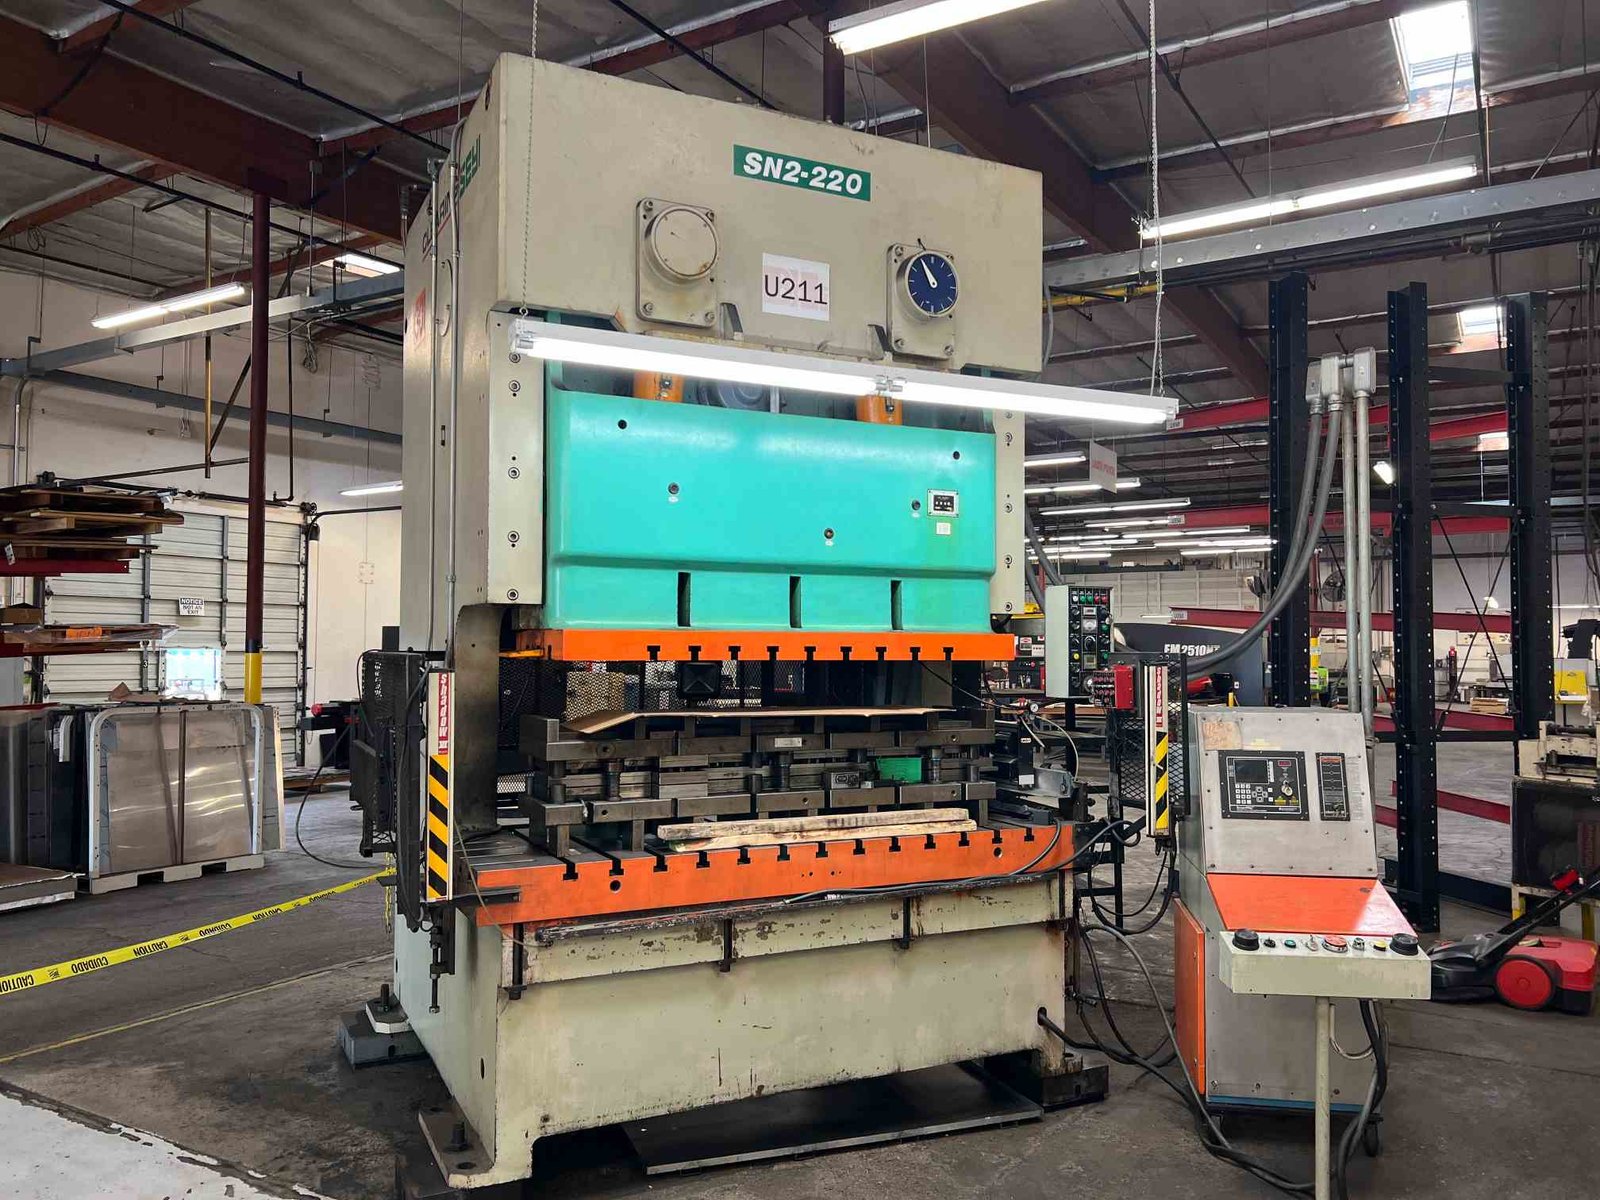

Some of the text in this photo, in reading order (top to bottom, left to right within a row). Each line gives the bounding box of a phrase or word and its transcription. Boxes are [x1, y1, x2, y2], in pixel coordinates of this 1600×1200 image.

[743, 152, 863, 195] SN2-220
[764, 274, 828, 304] U211
[133, 940, 169, 957] CAUTION
[71, 956, 109, 974] CUIDADO
